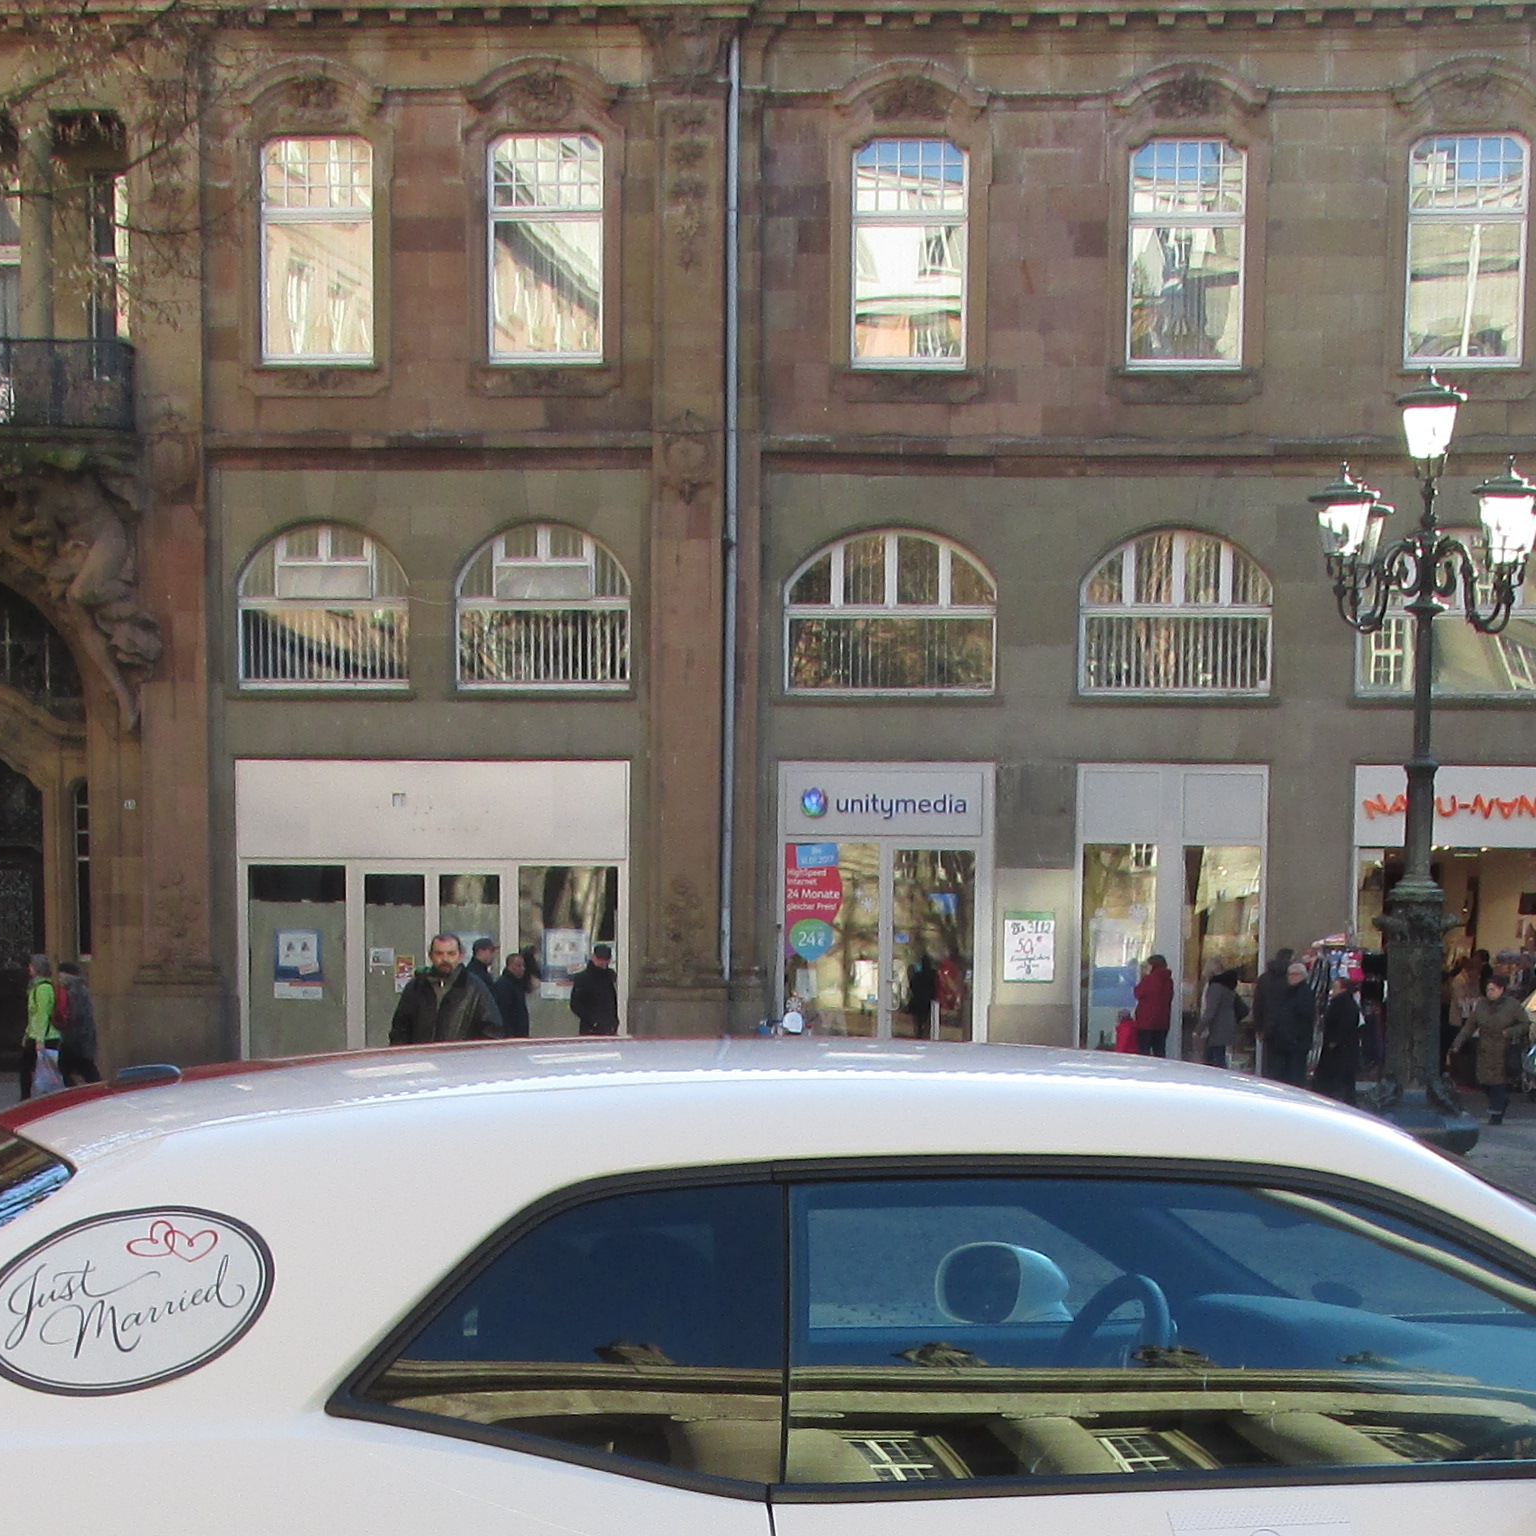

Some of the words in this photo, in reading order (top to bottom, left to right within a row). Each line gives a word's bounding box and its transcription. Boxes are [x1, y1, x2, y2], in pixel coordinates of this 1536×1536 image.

[836, 793, 967, 820] unitymedia
[786, 888, 800, 899] 24
[801, 888, 841, 899] Monate
[797, 931, 816, 947] 24
[5, 1260, 161, 1350] Just
[40, 1254, 245, 1359] Married
